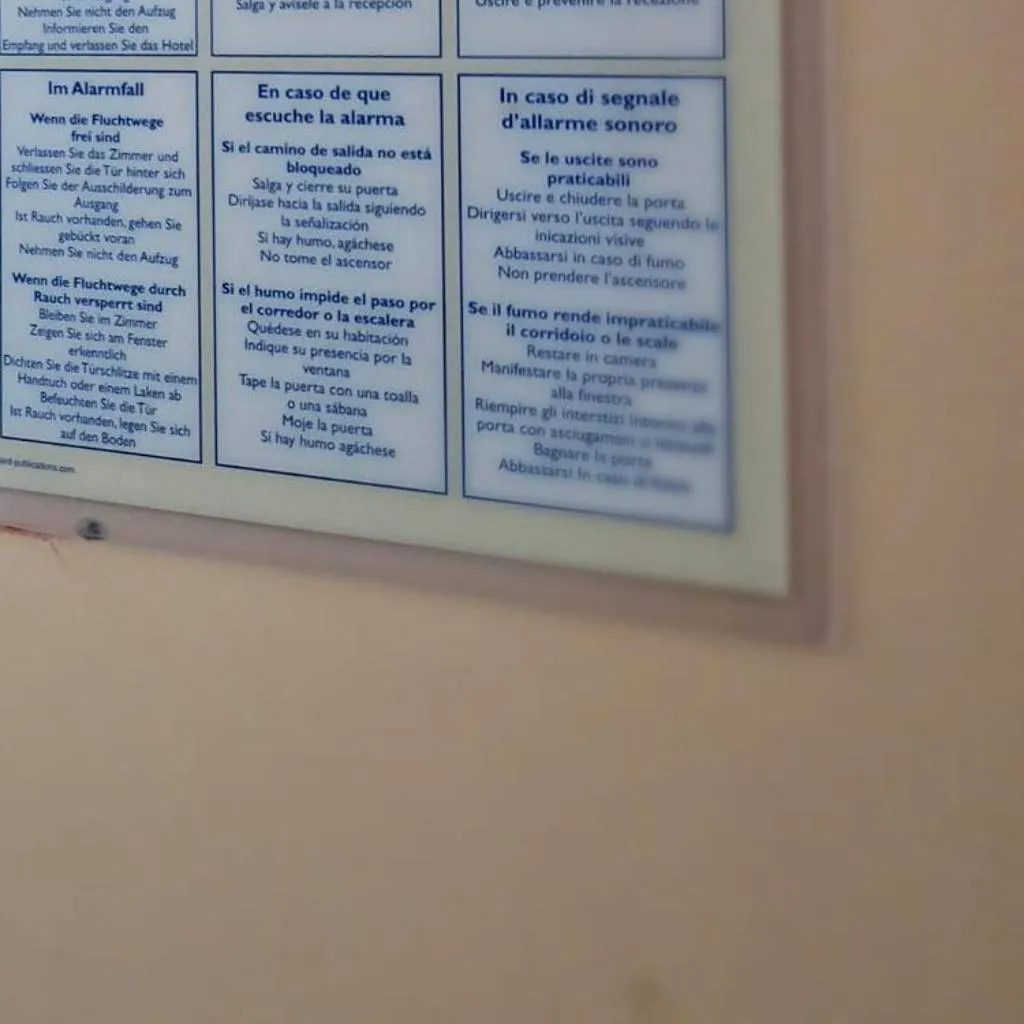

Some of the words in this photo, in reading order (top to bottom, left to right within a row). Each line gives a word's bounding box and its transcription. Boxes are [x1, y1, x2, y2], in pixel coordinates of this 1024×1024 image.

[47, 78, 68, 95] Im
[70, 78, 144, 96] Alarmfall
[256, 82, 279, 99] En
[284, 87, 324, 100] caso
[329, 83, 351, 100] de
[355, 88, 391, 105] que
[499, 85, 518, 104] In
[524, 91, 568, 104] caso
[575, 86, 594, 105] di
[600, 87, 679, 110] segnale
[29, 110, 66, 124] Wenn
[68, 111, 88, 125] die
[90, 111, 164, 130] Fluchtwege
[244, 106, 314, 124] escuche
[318, 106, 335, 124] la
[340, 107, 405, 126] alarma
[501, 111, 597, 131] d'allarme
[604, 119, 677, 133] sonoro
[70, 128, 92, 142] frei
[94, 128, 120, 143] sind
[285, 158, 361, 178] bloqueado
[519, 148, 540, 164] Se
[544, 149, 559, 165] le
[564, 150, 613, 166] uscite
[618, 156, 658, 168] sono
[546, 169, 630, 189] praticabili
[33, 288, 71, 305] Rauch
[73, 296, 134, 312] versperrt
[135, 297, 163, 312] sind
[240, 300, 253, 315] el
[255, 304, 320, 320] corredor
[335, 307, 350, 323] la
[353, 311, 415, 328] escalera
[281, 411, 313, 433] Moje
[316, 415, 327, 432] la
[330, 421, 373, 437] puerta
